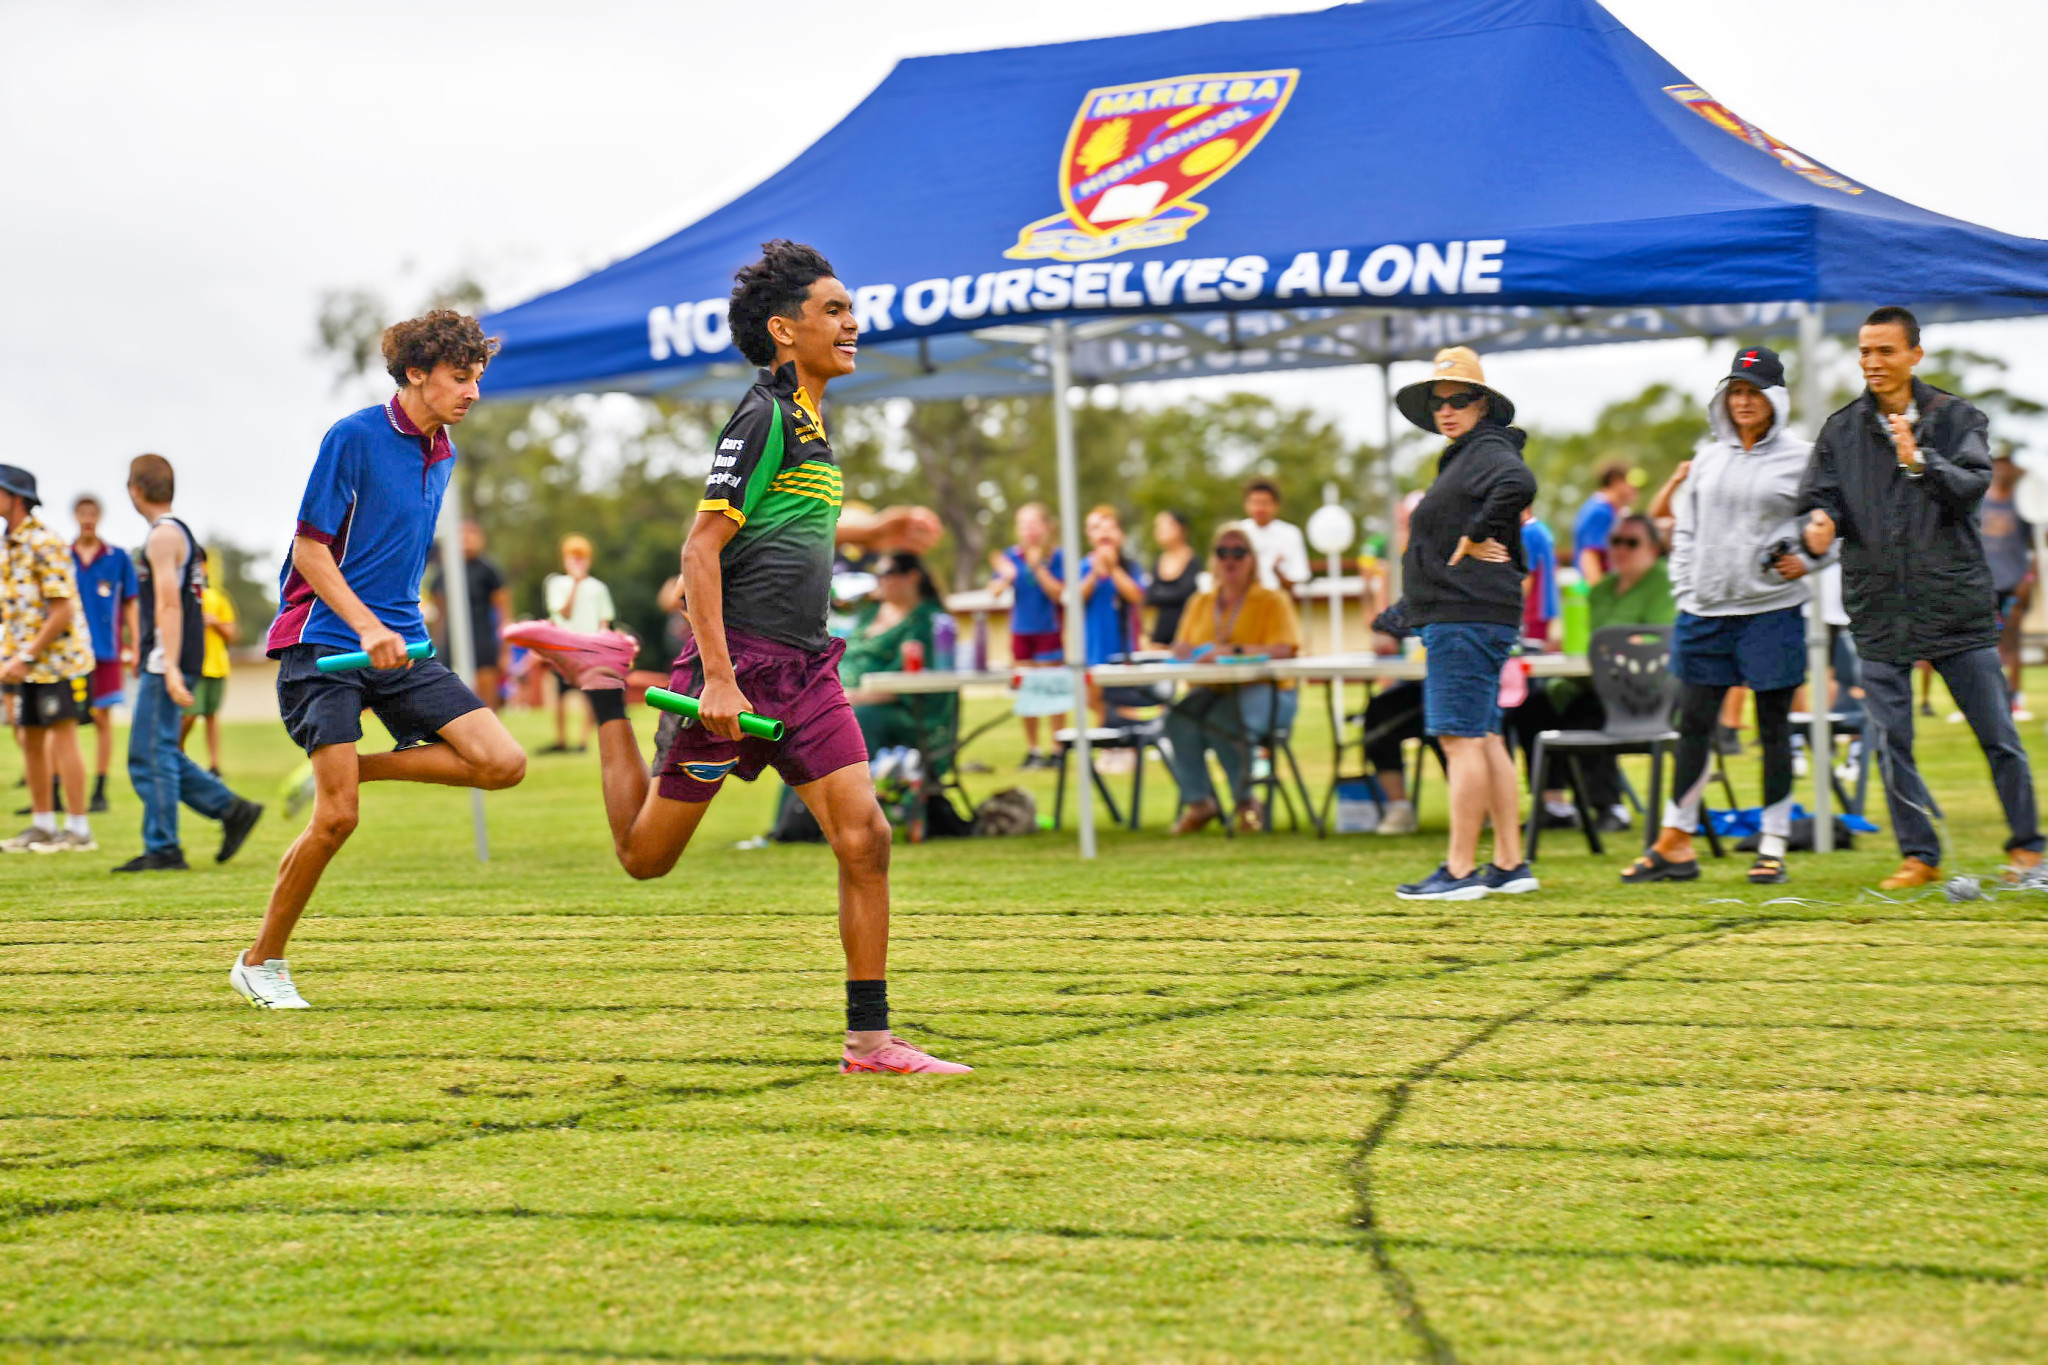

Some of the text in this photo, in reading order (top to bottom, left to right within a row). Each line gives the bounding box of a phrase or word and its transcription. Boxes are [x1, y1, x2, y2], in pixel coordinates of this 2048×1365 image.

[1093, 78, 1278, 117] MAREEBA
[1078, 105, 1253, 197] HIGH SCHOOL
[648, 297, 735, 361] NO
[902, 255, 1270, 327] OURSELVES
[1274, 239, 1507, 299] ALONE
